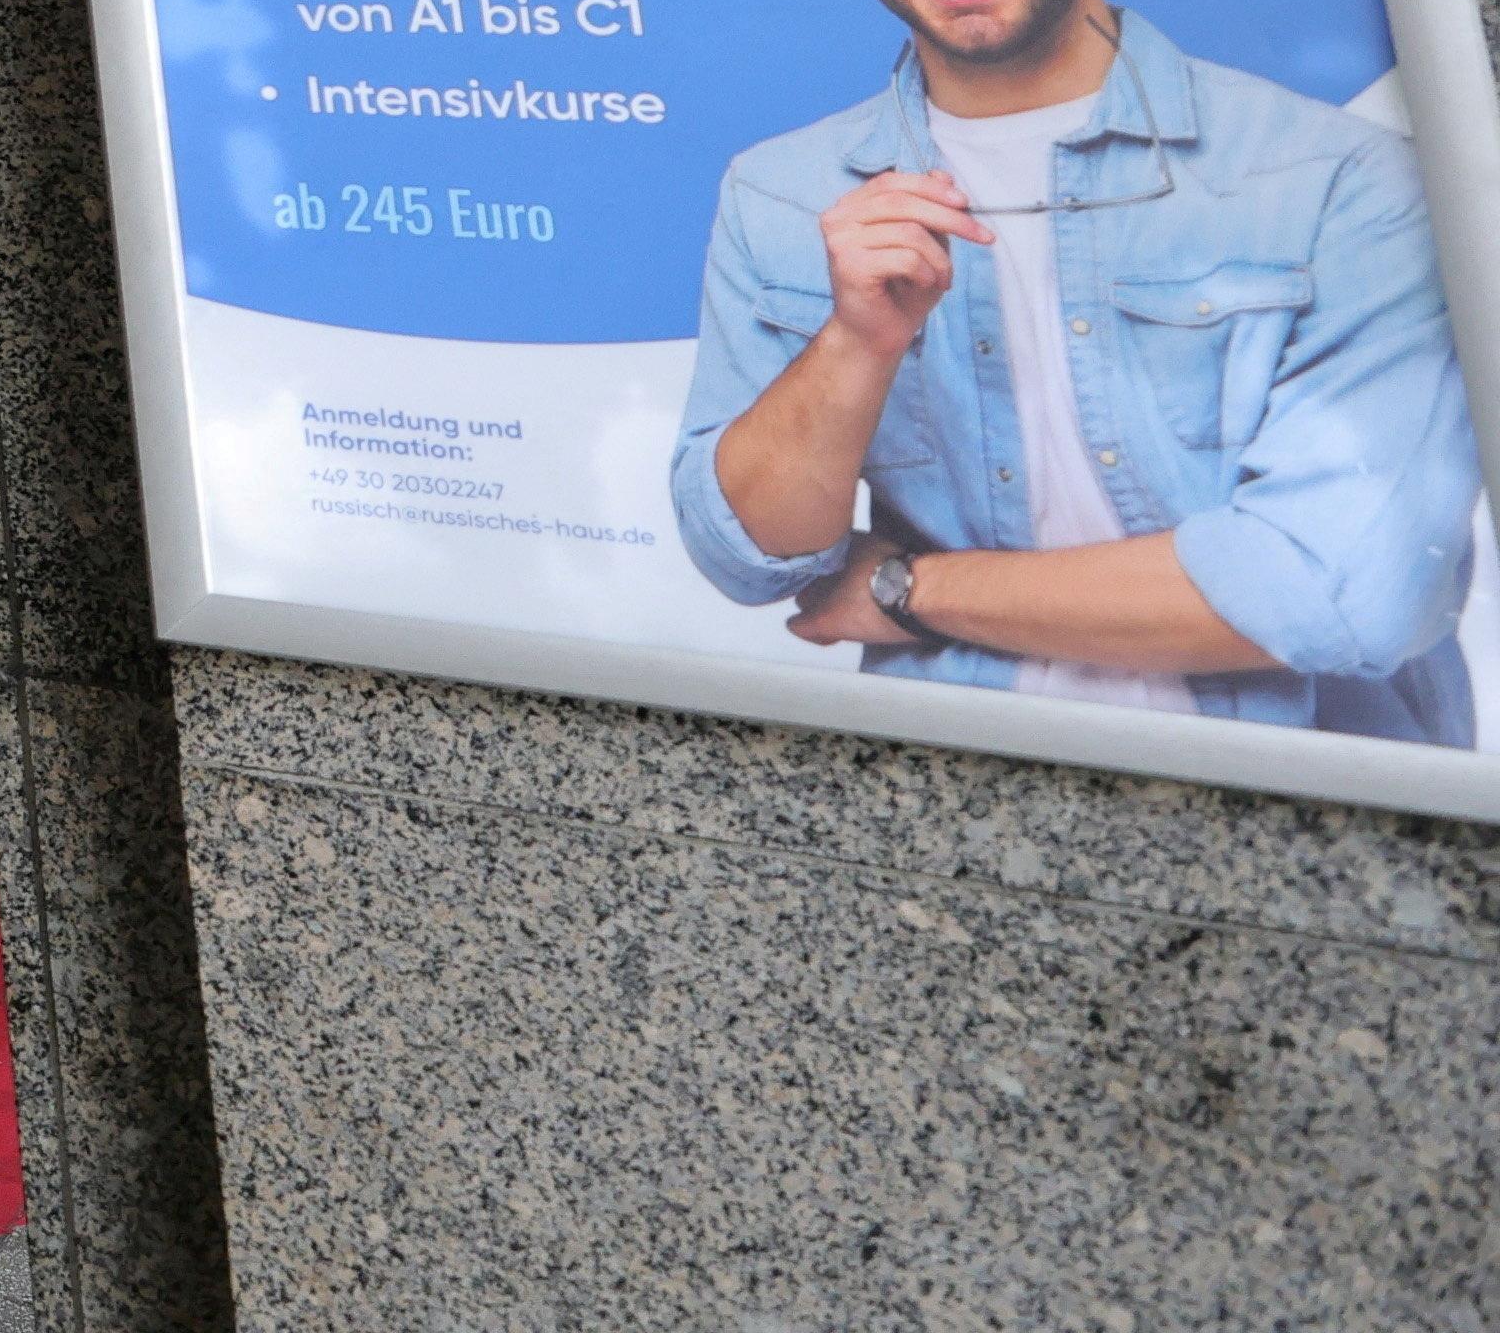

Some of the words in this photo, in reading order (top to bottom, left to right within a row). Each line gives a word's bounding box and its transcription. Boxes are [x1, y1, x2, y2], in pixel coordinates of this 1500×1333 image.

[298, 1, 395, 34] von
[307, 77, 667, 125] Intensivkurse
[272, 185, 328, 233] ab
[342, 185, 436, 238] 245
[451, 188, 556, 242] Euro
[302, 402, 459, 438] Anmeldung
[468, 420, 523, 439] und
[304, 428, 474, 461] Information:
[309, 467, 349, 486] +49
[355, 470, 385, 490] 30
[392, 474, 505, 501] 20302247
[312, 496, 656, 546] russisch@russisches-haus.de
